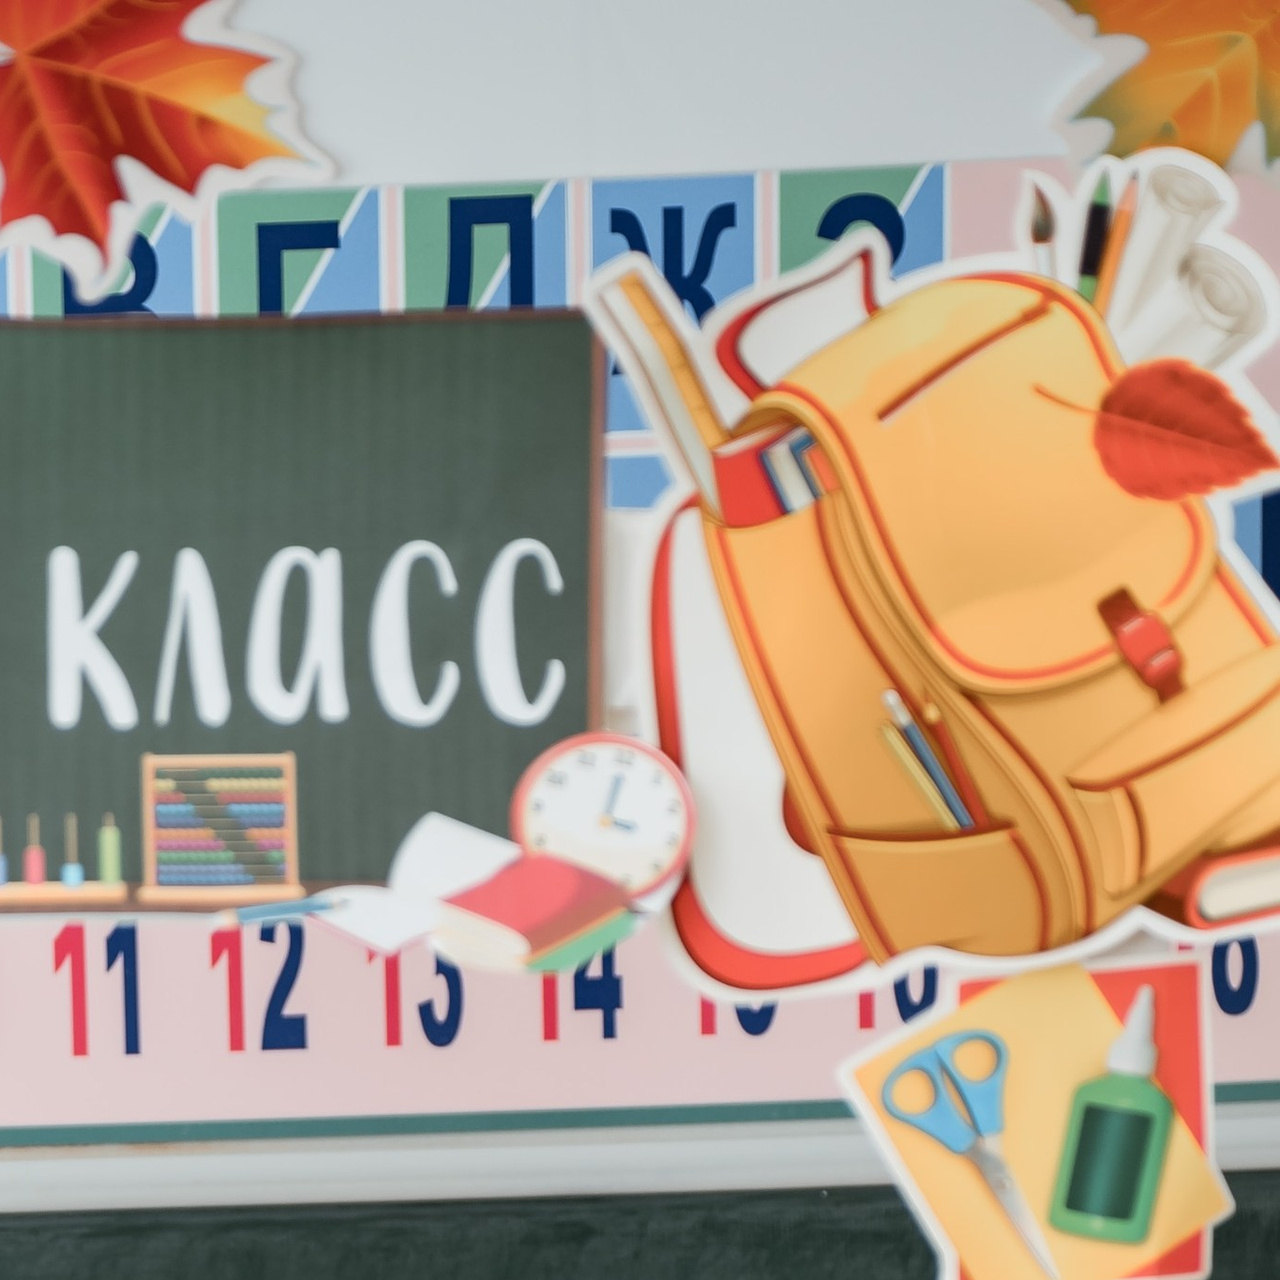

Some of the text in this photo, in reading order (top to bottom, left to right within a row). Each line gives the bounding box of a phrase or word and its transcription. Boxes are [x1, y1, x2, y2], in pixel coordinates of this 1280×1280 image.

[46, 538, 566, 729] класс
[54, 920, 142, 1057] 11
[209, 918, 309, 1052] 12
[367, 950, 464, 1048] 13
